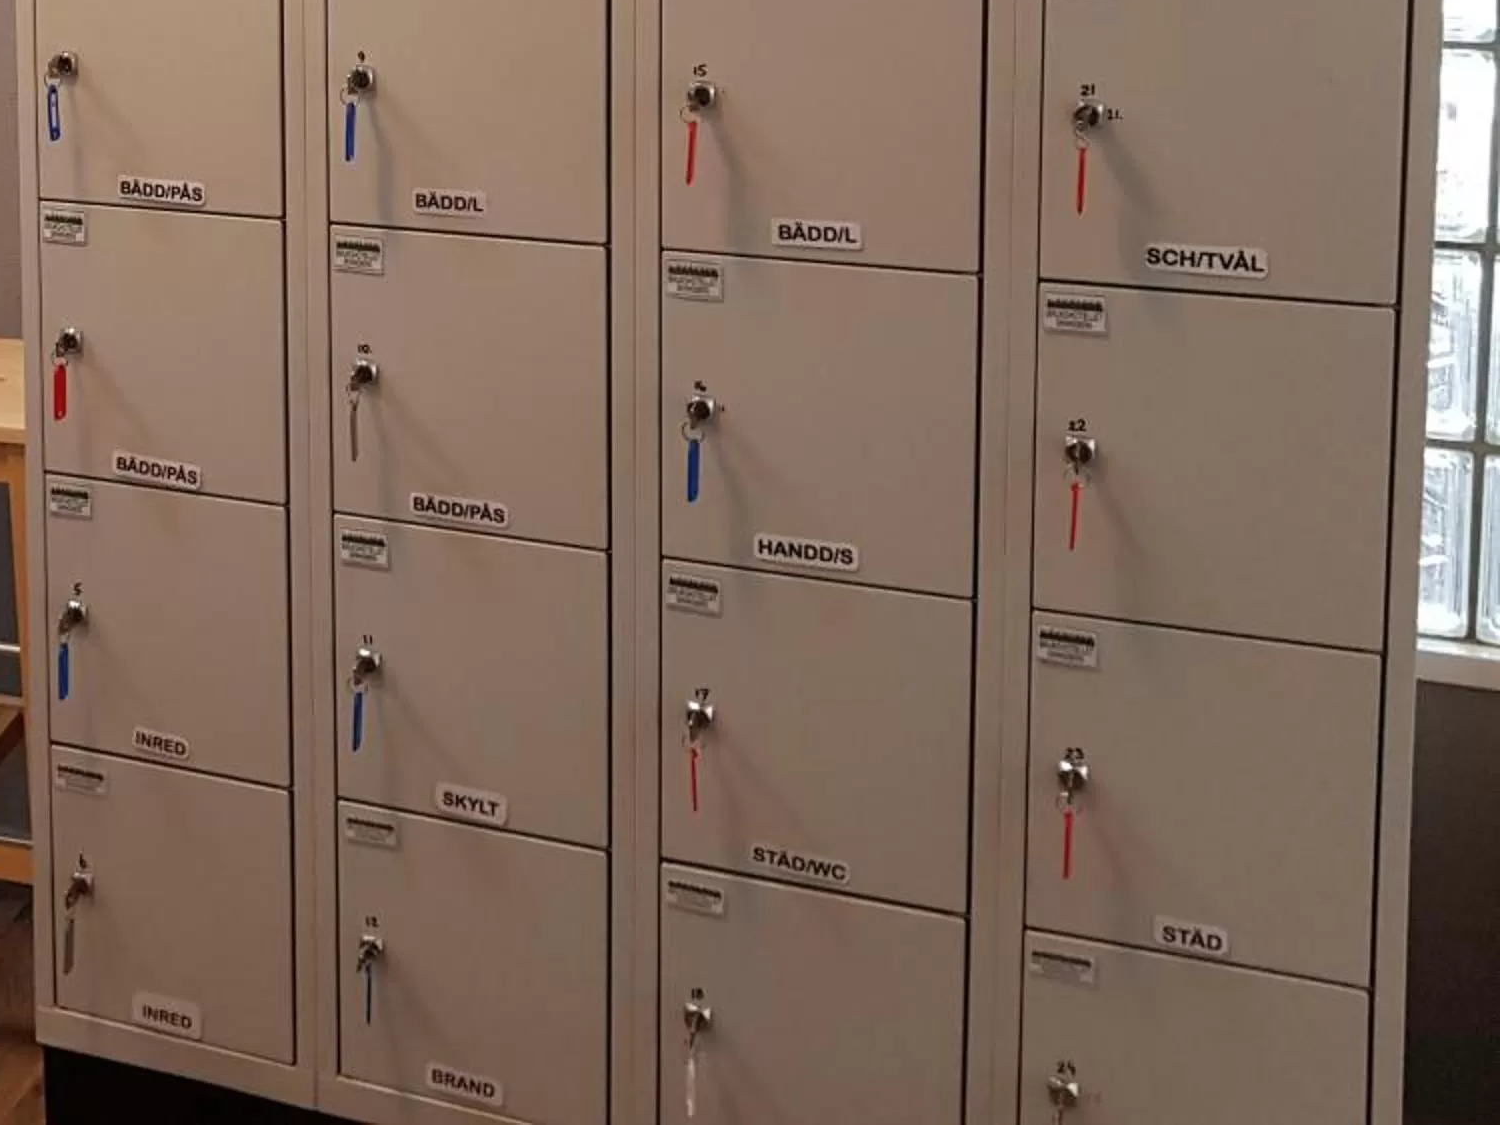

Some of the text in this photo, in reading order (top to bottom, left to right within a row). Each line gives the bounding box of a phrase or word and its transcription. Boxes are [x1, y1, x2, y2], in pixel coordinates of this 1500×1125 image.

[693, 63, 707, 77] 15
[120, 180, 202, 202] BÄDD/PÅS
[415, 192, 484, 212] BÄDD/L
[778, 222, 857, 244] BÄDD/L
[1147, 248, 1265, 273] SCH/TVÅL
[116, 456, 198, 485] BÄDD/PÅS
[413, 496, 505, 524] BÄDD/PÅS
[758, 538, 853, 565] HANDD/S
[135, 731, 186, 756] INRED
[443, 791, 499, 816] SKYLT
[753, 847, 846, 881] STÄD/WC
[1162, 926, 1223, 952] STÄD
[142, 1004, 193, 1029] INRED
[432, 1068, 496, 1099] BRAND
